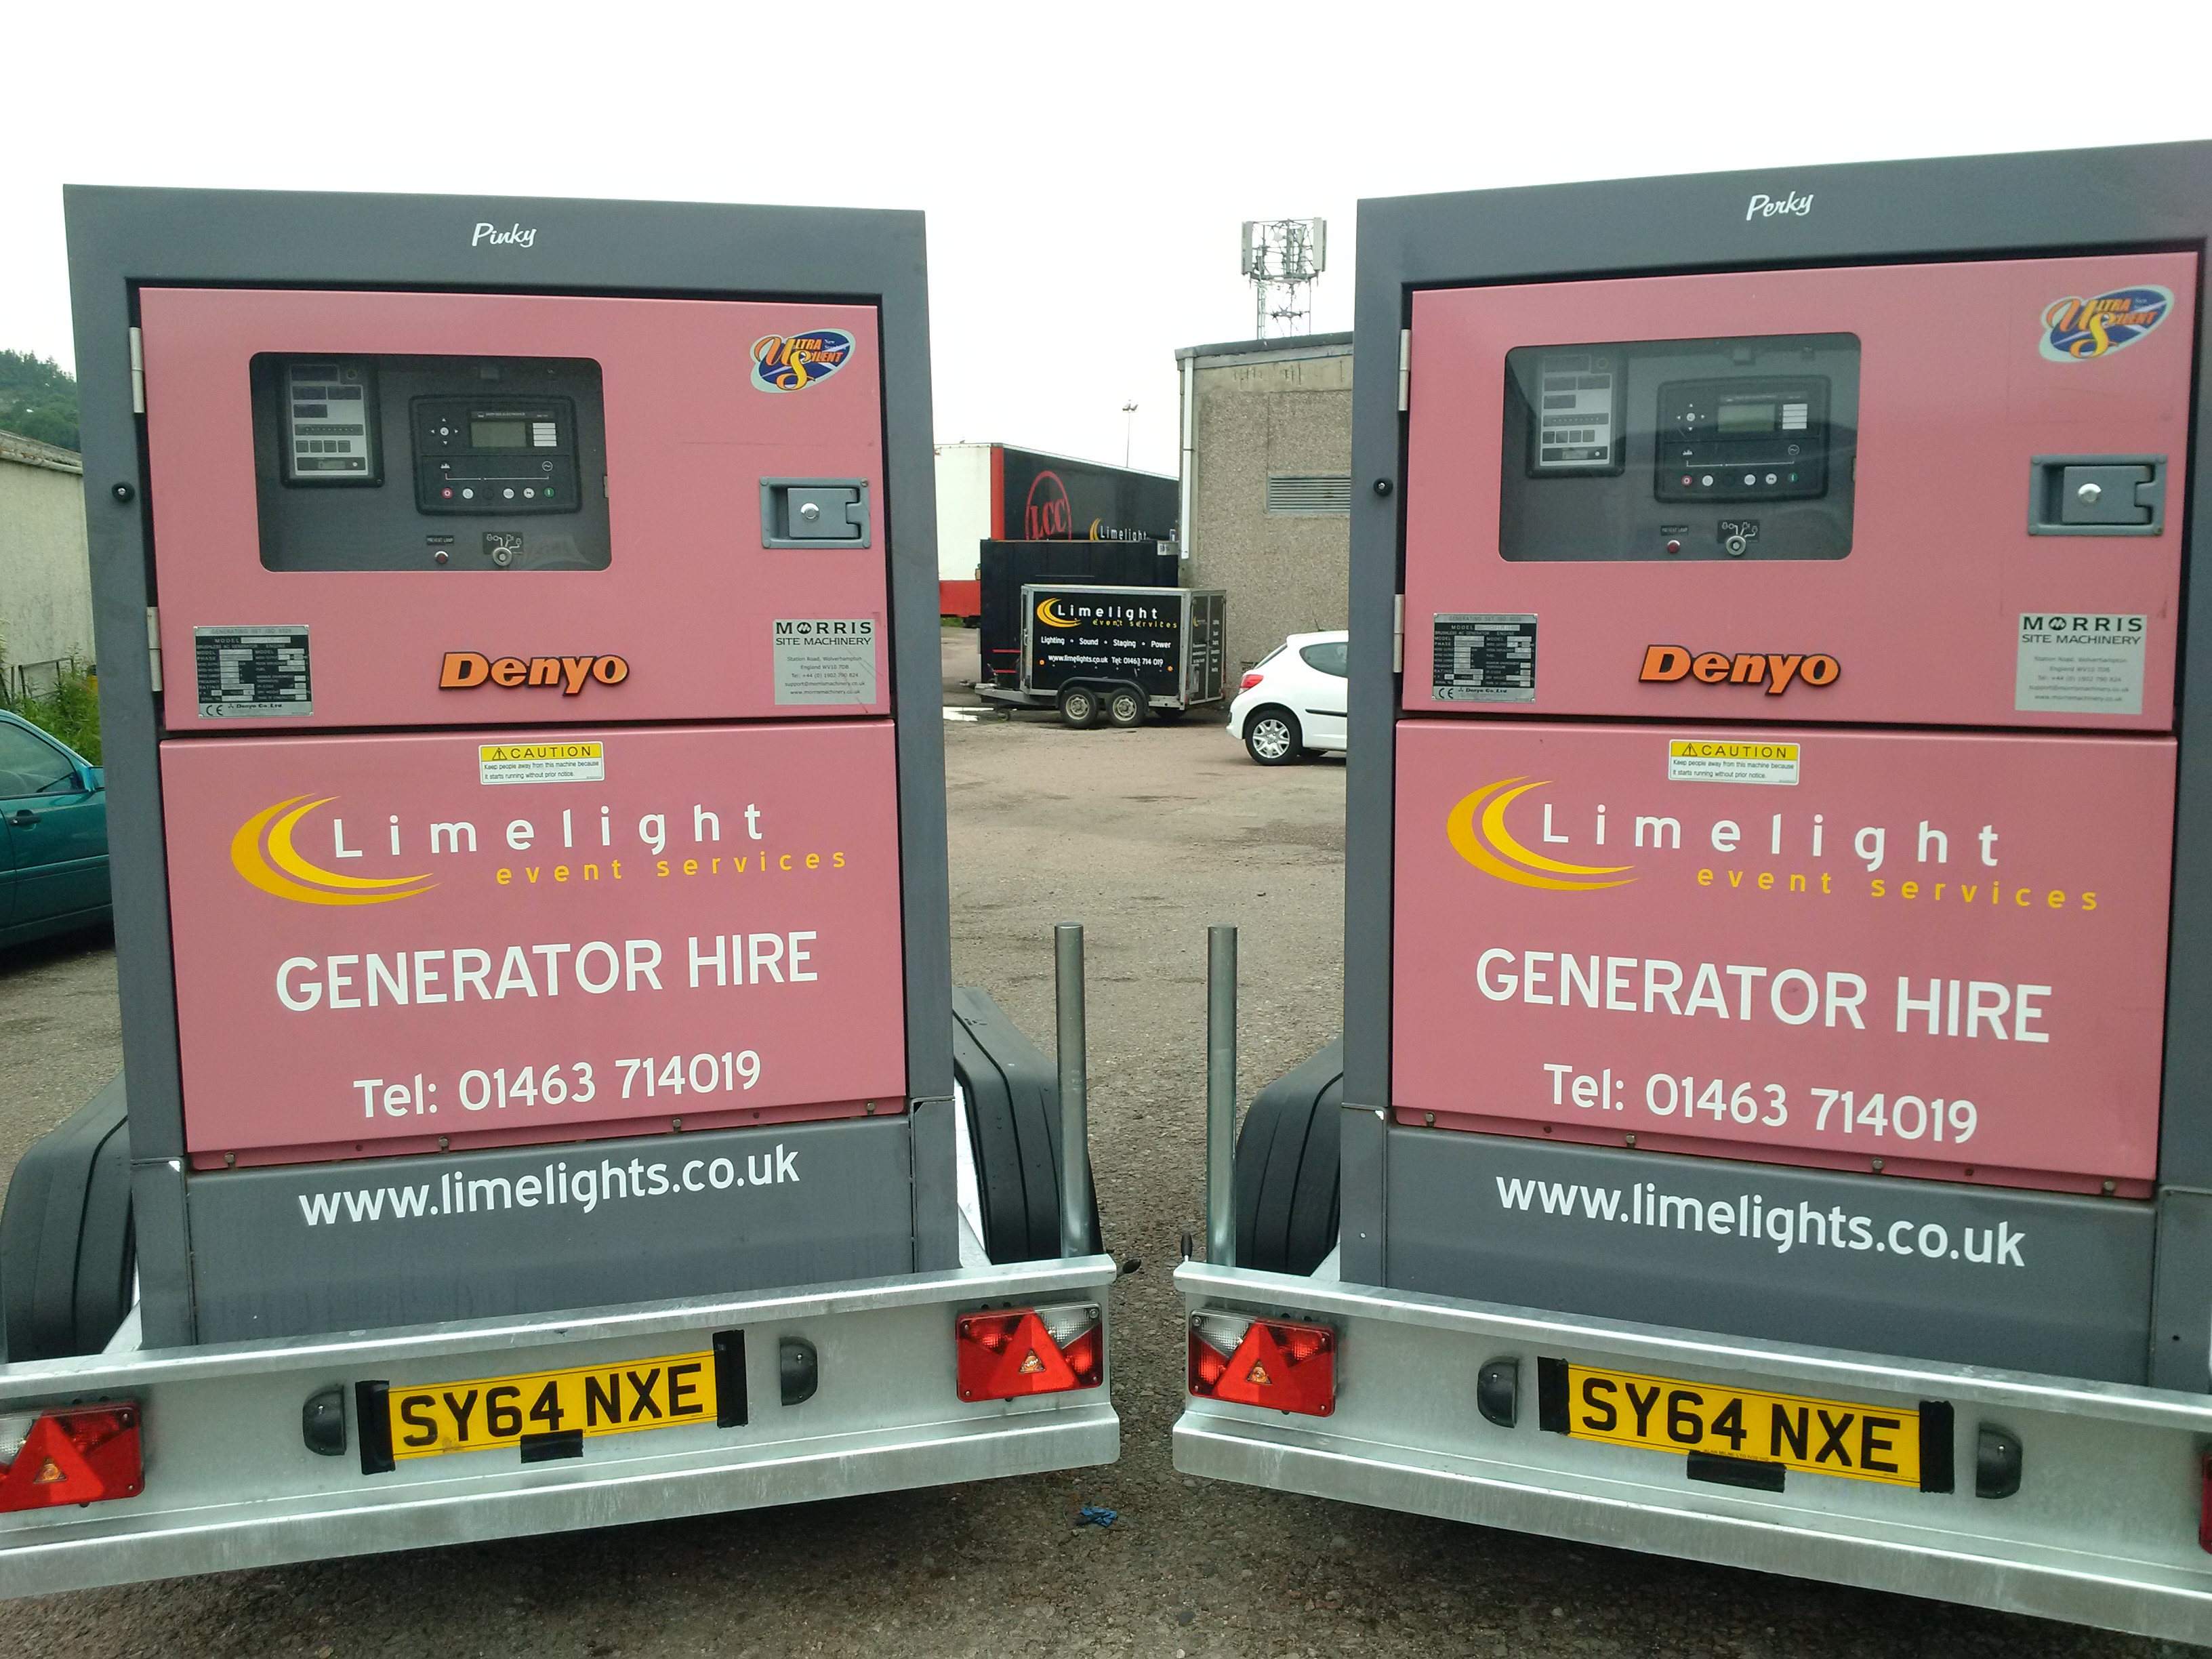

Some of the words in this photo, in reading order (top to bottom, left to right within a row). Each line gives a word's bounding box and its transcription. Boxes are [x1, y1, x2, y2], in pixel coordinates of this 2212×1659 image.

[1746, 190, 1814, 221] Perky
[472, 222, 537, 248] Pinky
[1029, 498, 1067, 539] LCC
[1100, 525, 1147, 541] Limelight
[775, 621, 872, 634] MORRIS
[1057, 604, 1158, 621] Limelight
[1092, 618, 1123, 626] event
[1129, 619, 1178, 629] services
[2023, 616, 2142, 632] MORRIS
[775, 637, 800, 645] SITE
[804, 637, 872, 645] MACHINERY
[1040, 635, 1065, 646] Lighting
[1079, 637, 1099, 646] Sound
[1113, 638, 1136, 649] Staging
[1151, 640, 1172, 649] Power
[2022, 634, 2052, 643] SITE
[2055, 634, 2142, 645] MACHINERY
[438, 651, 630, 697] Denyo
[1048, 654, 1109, 664] www.limelights.co.uk
[1123, 657, 1141, 665] 01463
[1638, 644, 1841, 696] Denyo
[510, 745, 591, 759] CAUTION
[1701, 744, 1786, 758] CAUTION
[333, 803, 764, 856] Limelight
[1542, 803, 1999, 872] Limelight
[496, 858, 622, 885] event
[657, 849, 846, 878] services
[1697, 867, 1832, 895] event
[1870, 876, 2097, 911] services
[275, 939, 663, 1012] GENERATOR
[689, 930, 819, 988] HIRE
[1476, 948, 1868, 1030] GENERATOR
[1897, 976, 2052, 1043] HIRE
[353, 1073, 438, 1118] Tel:
[459, 1061, 595, 1111] 01463
[615, 1050, 761, 1099] 714019
[1543, 1063, 1624, 1111] Tel:
[1645, 1073, 1788, 1127] 01463
[1810, 1088, 1978, 1143] 714019
[298, 1143, 800, 1227] www.limelights.co.uk
[1496, 1176, 2026, 1267] www.limelights.co.uk
[400, 1380, 565, 1448] SY64
[585, 1363, 704, 1428] NXE
[1582, 1377, 1747, 1451] SY64
[1769, 1403, 1901, 1473] NXE
